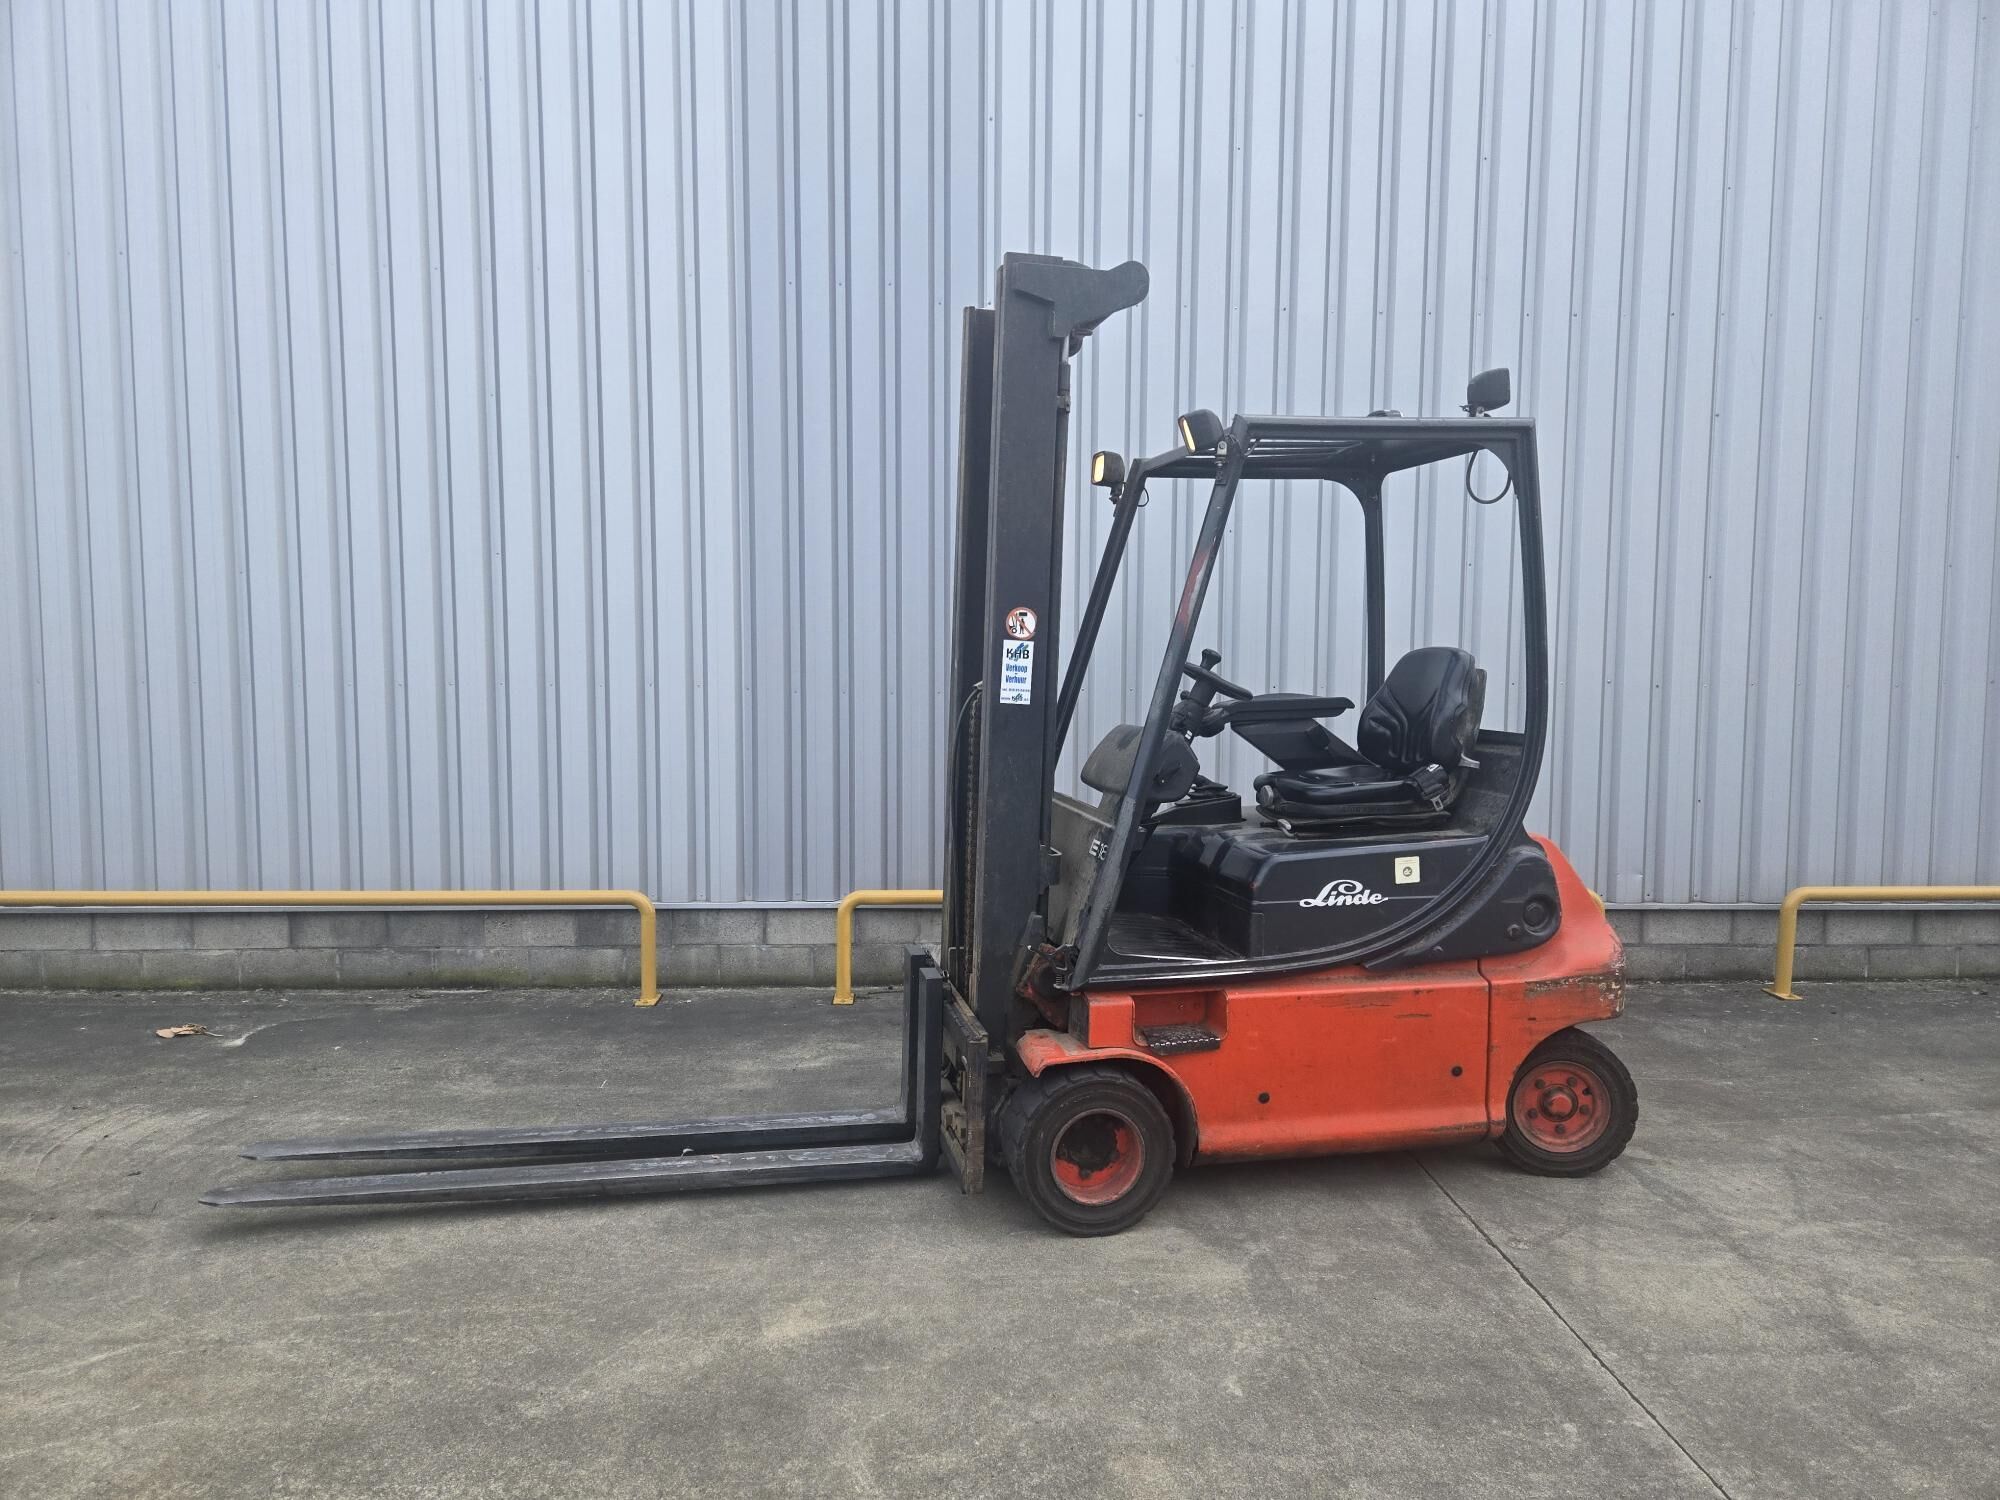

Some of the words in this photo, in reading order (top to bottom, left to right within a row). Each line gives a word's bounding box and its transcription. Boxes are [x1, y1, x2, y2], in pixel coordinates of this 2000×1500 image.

[1006, 647, 1030, 660] KHB
[1005, 663, 1028, 674] Verkoop
[1005, 674, 1027, 684] Verhuur
[1300, 879, 1388, 907] Linde
